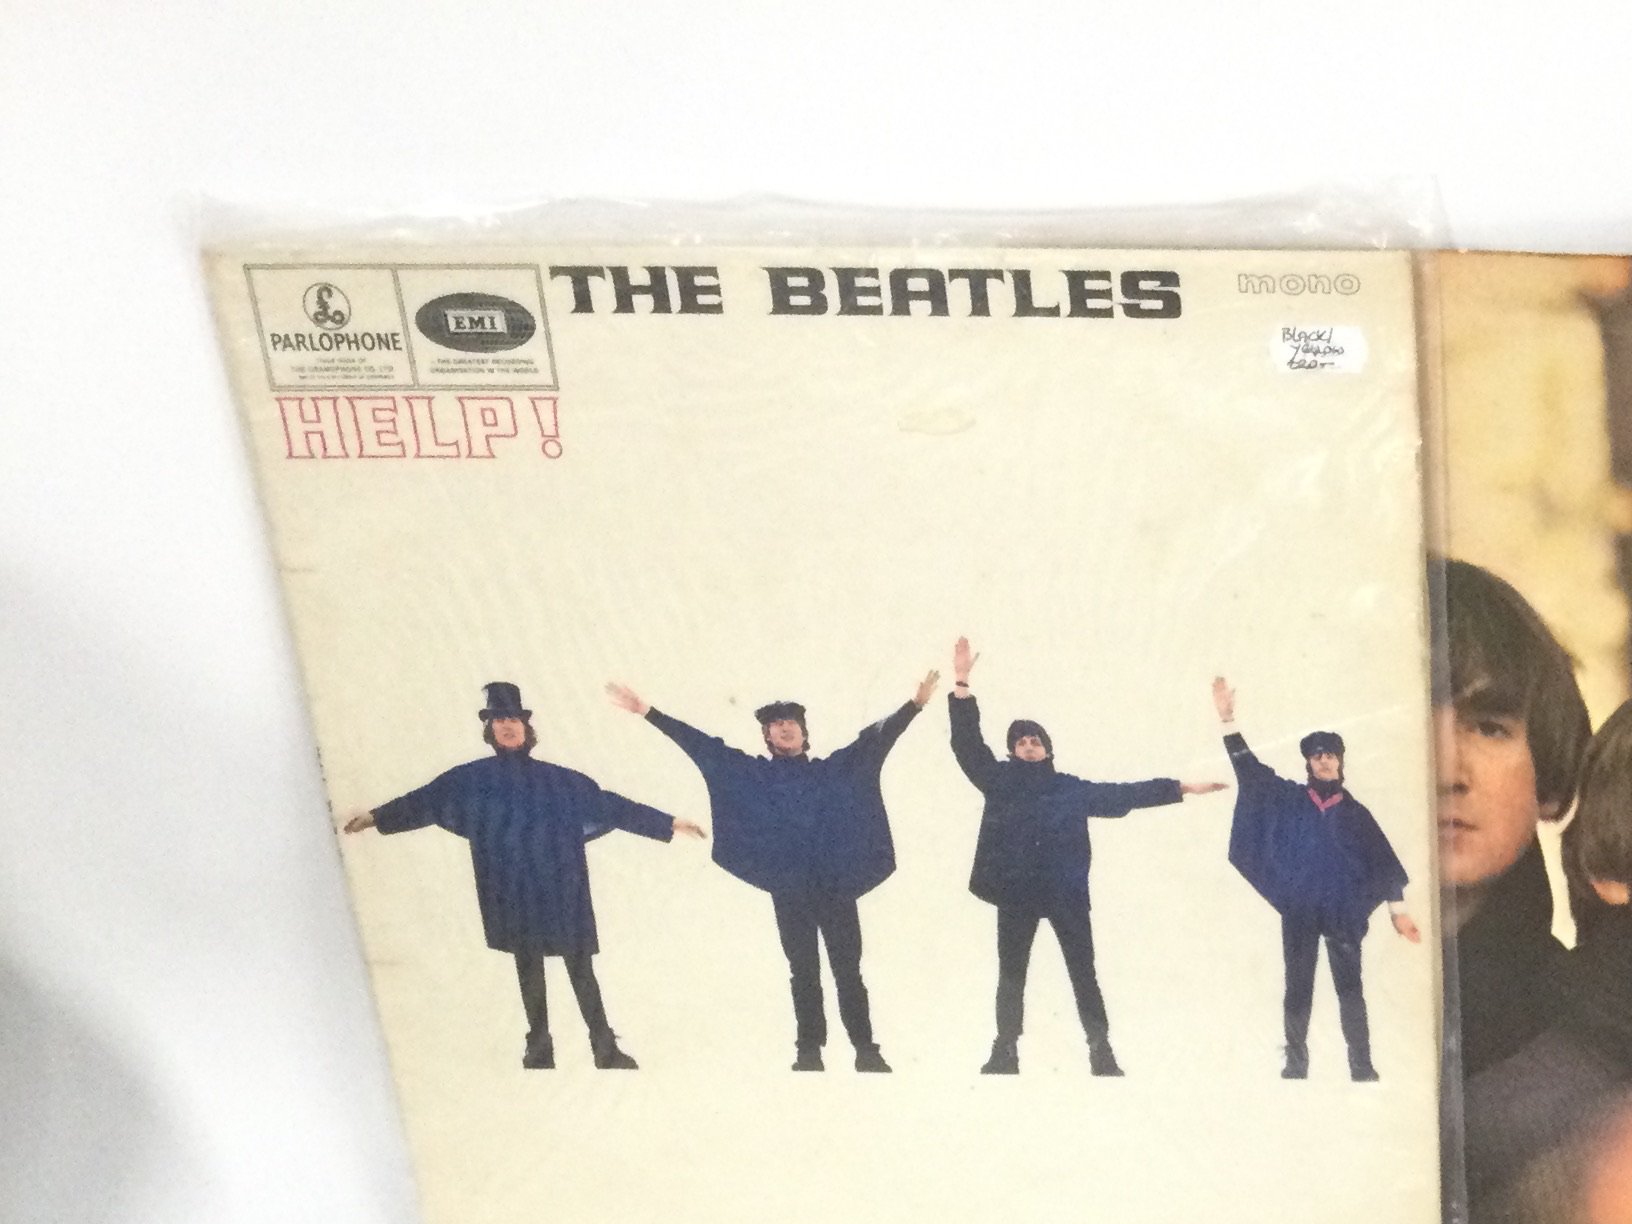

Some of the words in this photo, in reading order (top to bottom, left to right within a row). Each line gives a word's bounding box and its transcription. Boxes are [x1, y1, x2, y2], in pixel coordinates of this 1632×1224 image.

[548, 265, 724, 315] THE
[761, 267, 1183, 320] BEATLES
[1237, 273, 1361, 296] mono
[452, 315, 498, 331] EMI
[270, 332, 403, 352] PARLOPHONE
[275, 396, 563, 459] HELP!
